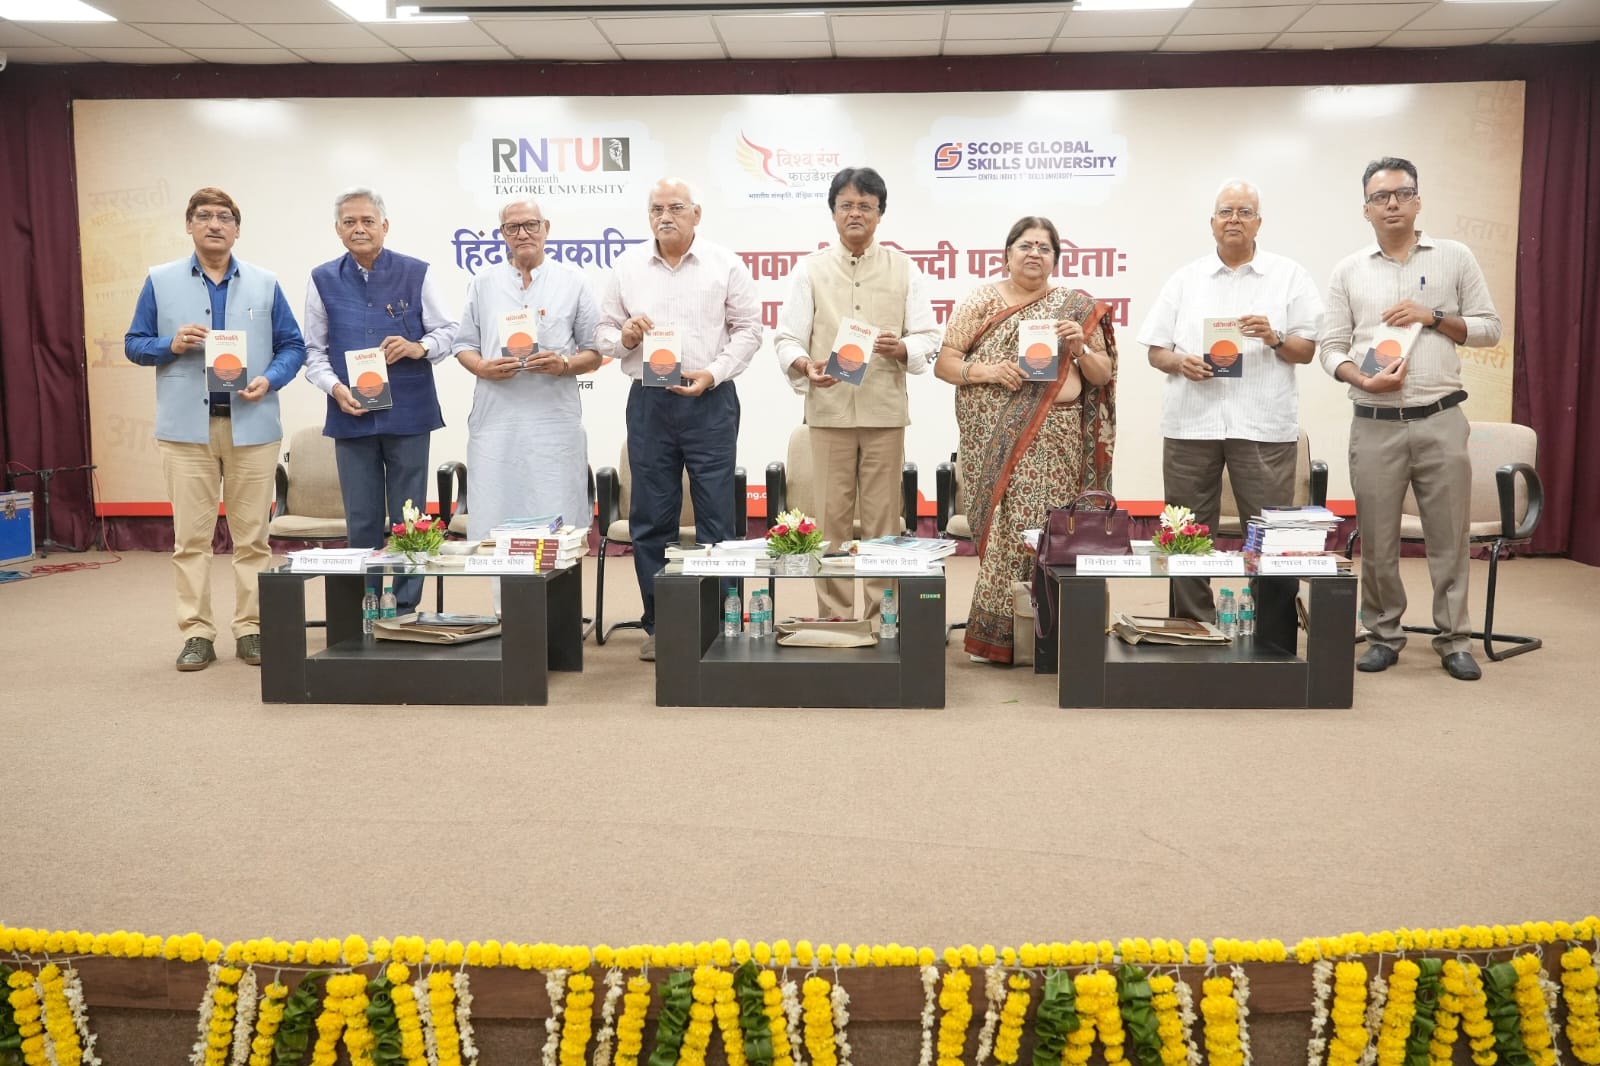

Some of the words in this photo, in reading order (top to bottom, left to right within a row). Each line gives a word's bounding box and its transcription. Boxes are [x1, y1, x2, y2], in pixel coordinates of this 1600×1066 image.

[492, 137, 601, 172] RNTU
[967, 142, 1023, 155] SCOPE
[1028, 141, 1094, 154] GLOBAL
[967, 158, 1021, 170] SKILLS
[1025, 156, 1117, 170] UNIVERSITY
[493, 174, 559, 184] Rabindranath
[494, 185, 545, 195] TAGORE
[549, 184, 625, 194] UNIVERSITY
